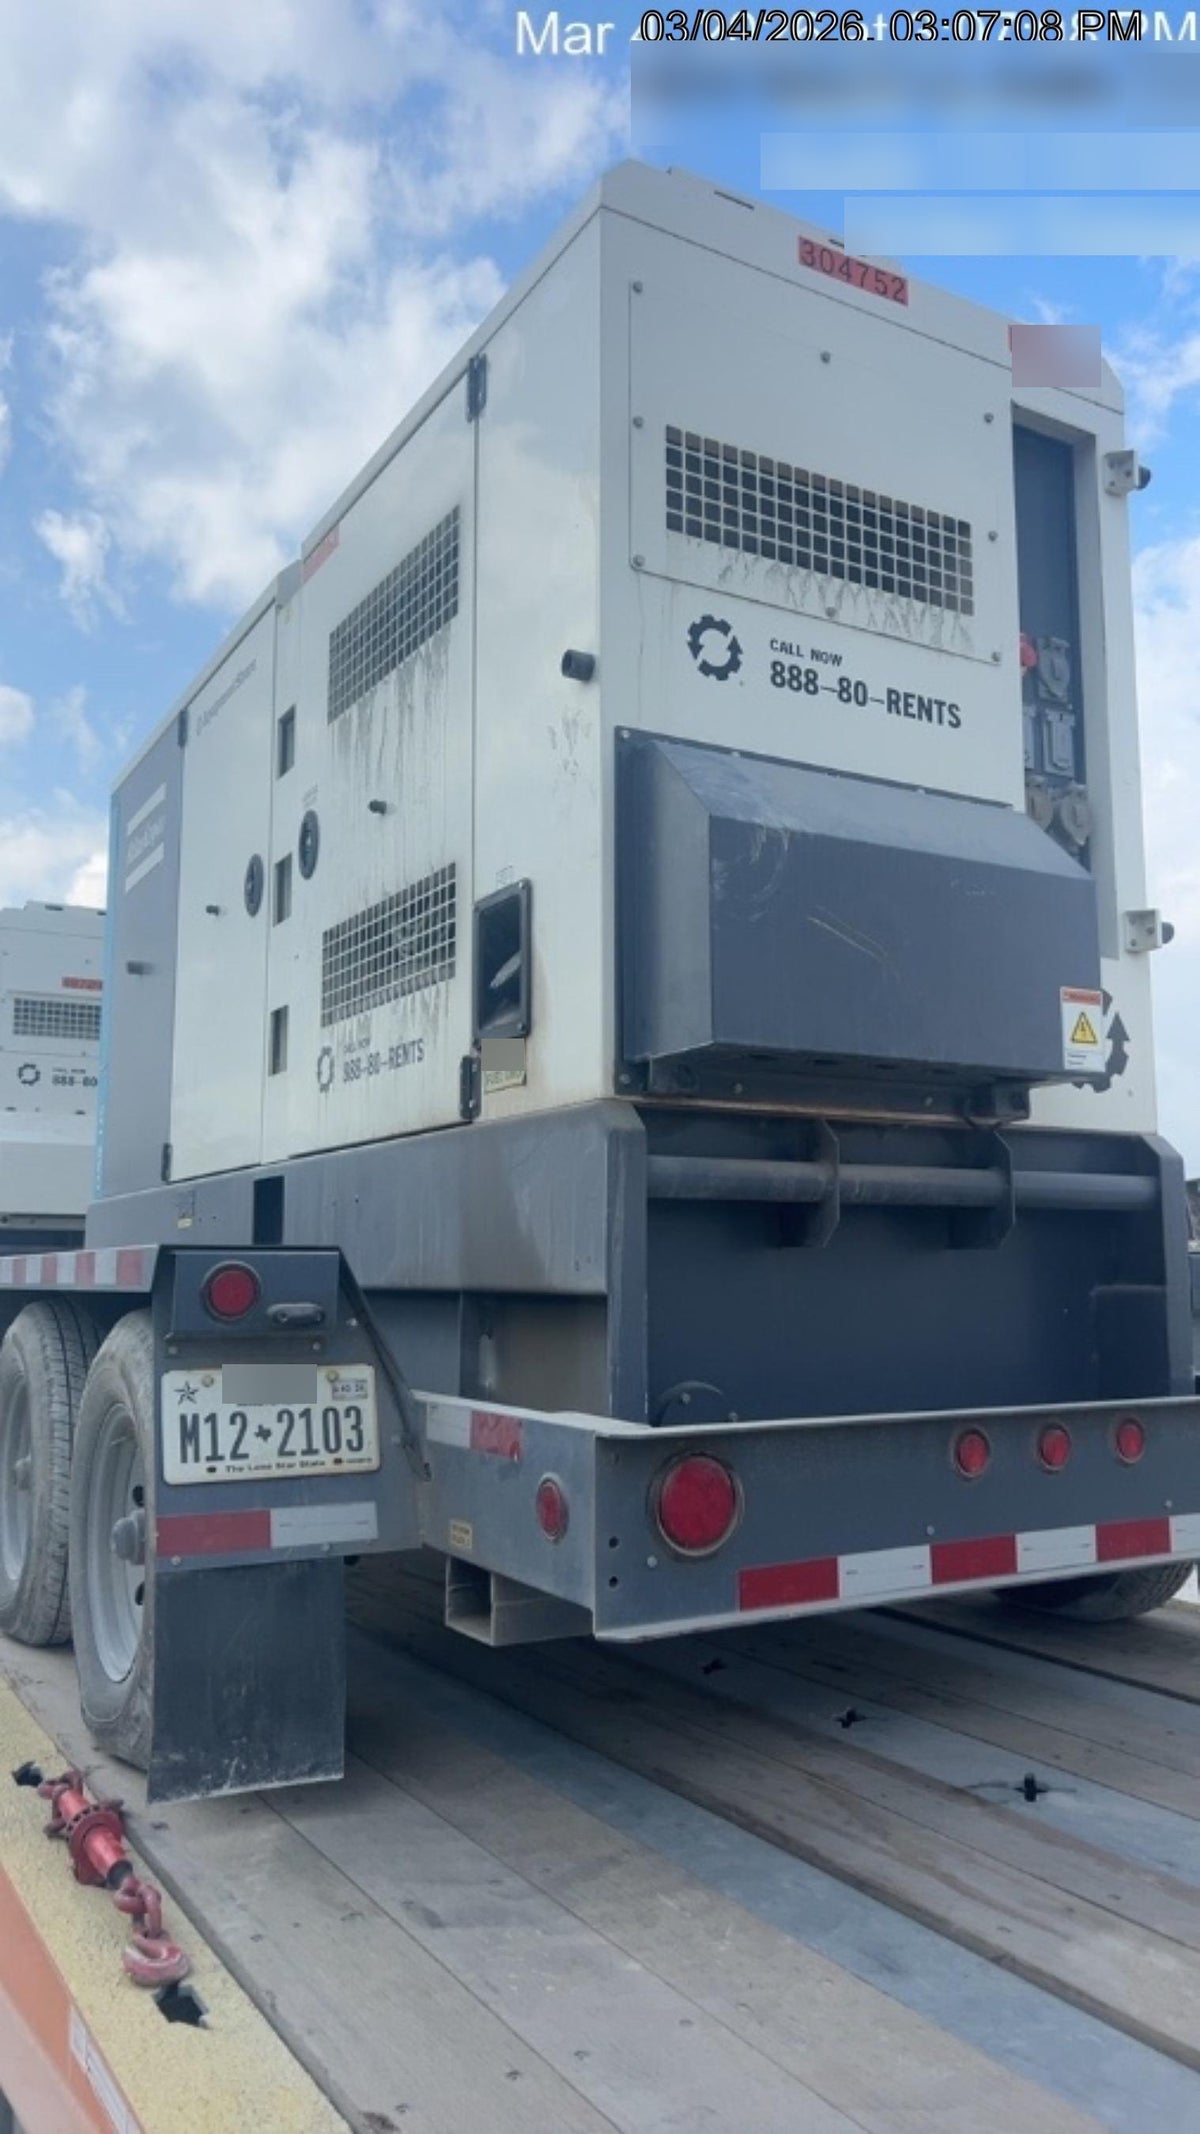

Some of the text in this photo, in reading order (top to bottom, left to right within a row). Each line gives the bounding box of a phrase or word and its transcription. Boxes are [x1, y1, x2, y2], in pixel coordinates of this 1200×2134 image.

[800, 238, 908, 302] 304752
[770, 638, 843, 667] CALL NOW
[179, 1405, 365, 1464] M12 2103
